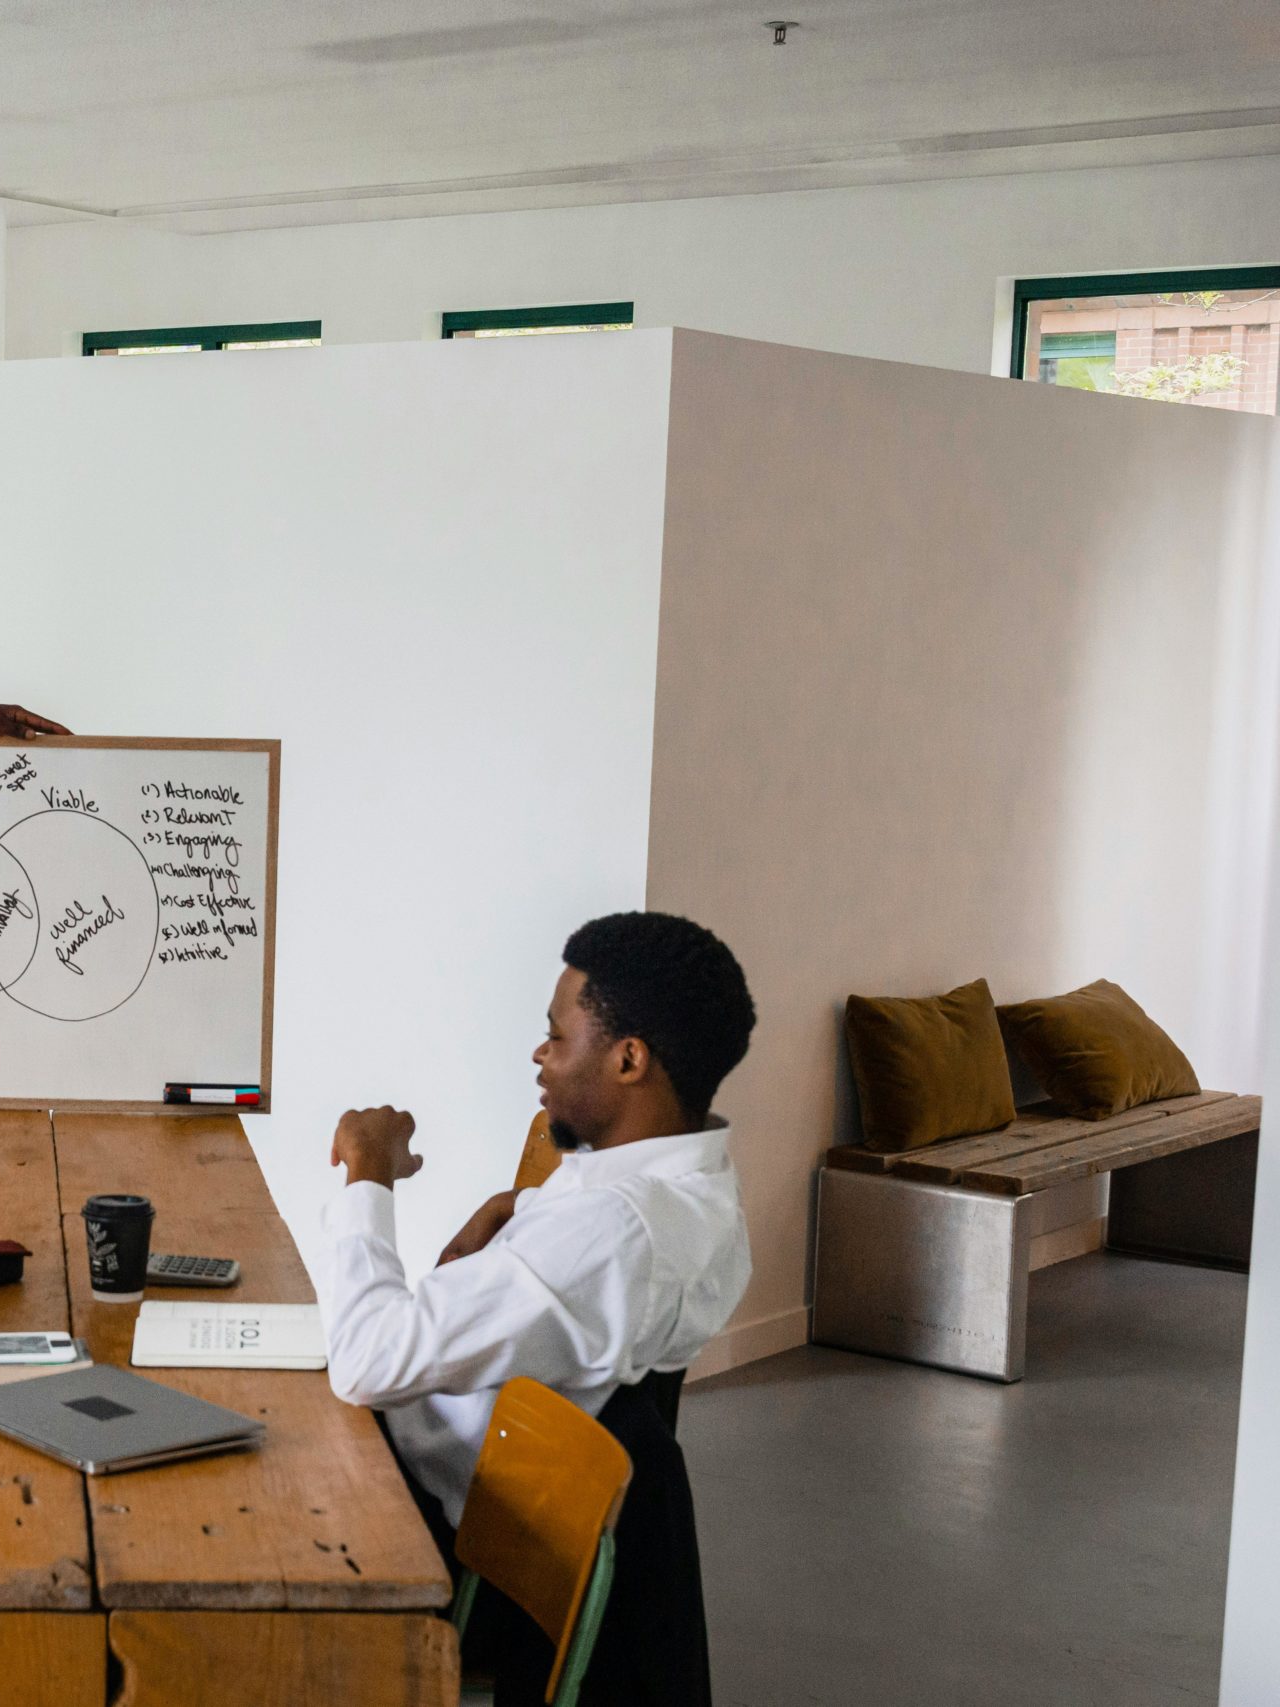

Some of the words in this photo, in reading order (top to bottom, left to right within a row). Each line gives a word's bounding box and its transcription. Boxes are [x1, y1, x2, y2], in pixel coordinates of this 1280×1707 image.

[41, 786, 99, 813] Viable
[164, 780, 244, 805] Actionable
[143, 833, 162, 846] (3)
[164, 830, 242, 867] Engaging
[163, 863, 240, 895] Challenging
[173, 893, 194, 909] Cost
[198, 892, 255, 917] Effective
[55, 895, 125, 976] financed
[213, 917, 258, 947] informed
